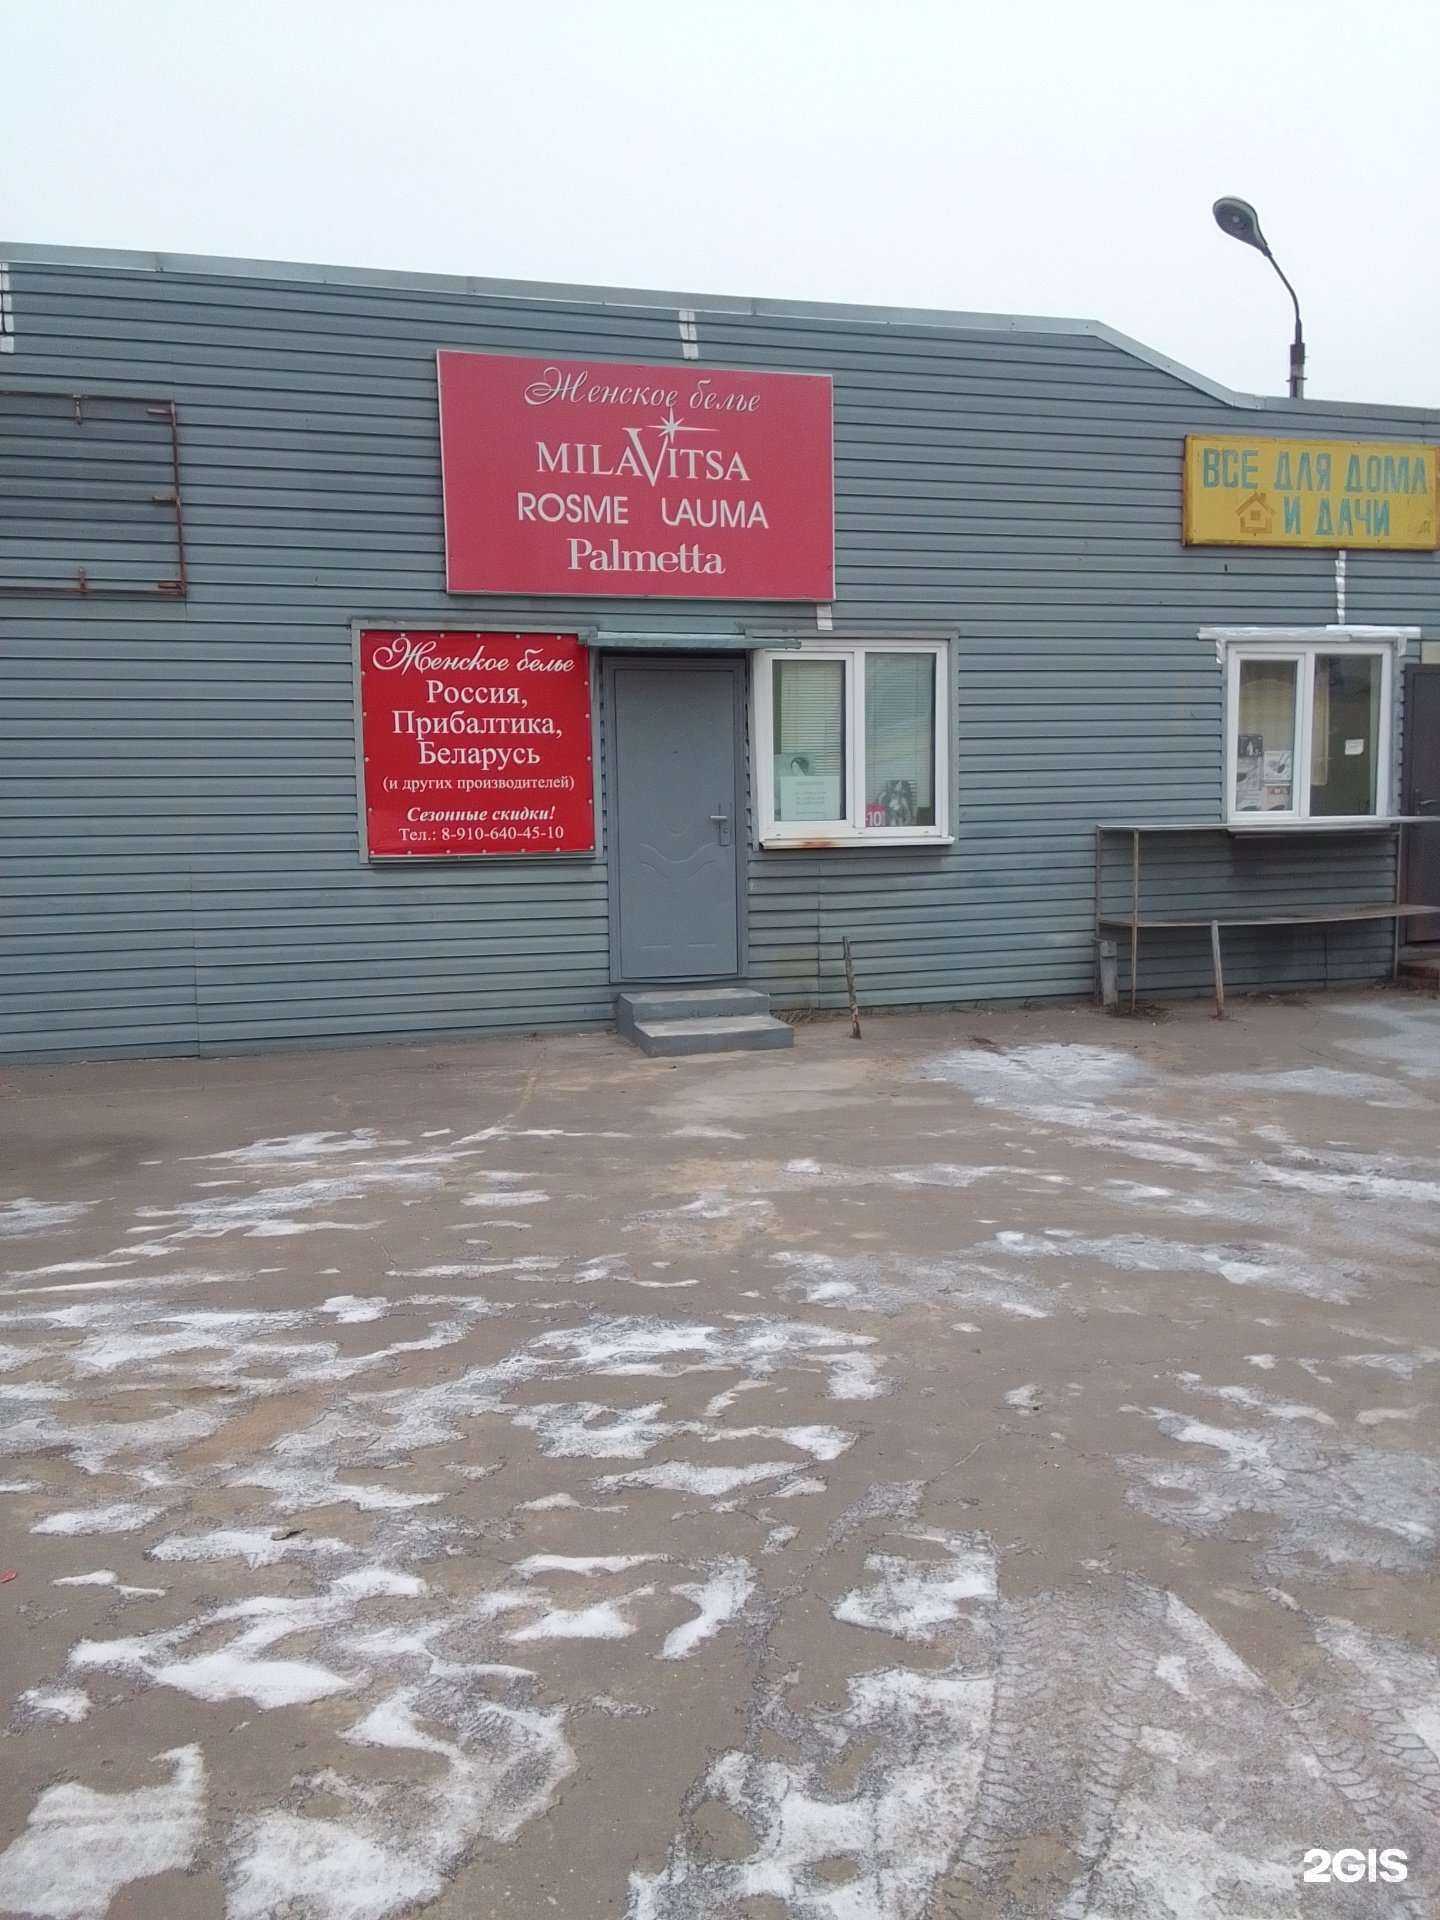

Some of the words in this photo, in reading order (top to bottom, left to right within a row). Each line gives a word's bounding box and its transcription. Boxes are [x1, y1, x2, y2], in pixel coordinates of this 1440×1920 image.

[524, 367, 679, 407] Женское
[690, 379, 761, 413] белье
[536, 427, 751, 487] MILAVITSA
[1203, 447, 1258, 490] ВСЕ
[1274, 451, 1332, 491] ДЛЯ
[1344, 453, 1428, 495] ДОМА
[517, 492, 629, 525] ROSME
[661, 497, 769, 529] LAUMA
[1283, 495, 1300, 535] И
[1316, 497, 1390, 537] ДАЧИ
[567, 537, 727, 575] Palmetta
[373, 637, 510, 676] Женское
[516, 648, 575, 672] белье
[426, 680, 528, 708] Россия,
[392, 710, 562, 741] Прибалтика,
[418, 741, 541, 771] Беларусь
[383, 776, 398, 792] (и
[402, 777, 452, 793] других
[457, 775, 575, 793] производителей)
[407, 807, 488, 822] Сезонные
[492, 805, 556, 822] скидки!
[399, 828, 436, 841] Тел.:
[441, 826, 564, 841] 8-910-640-45-10
